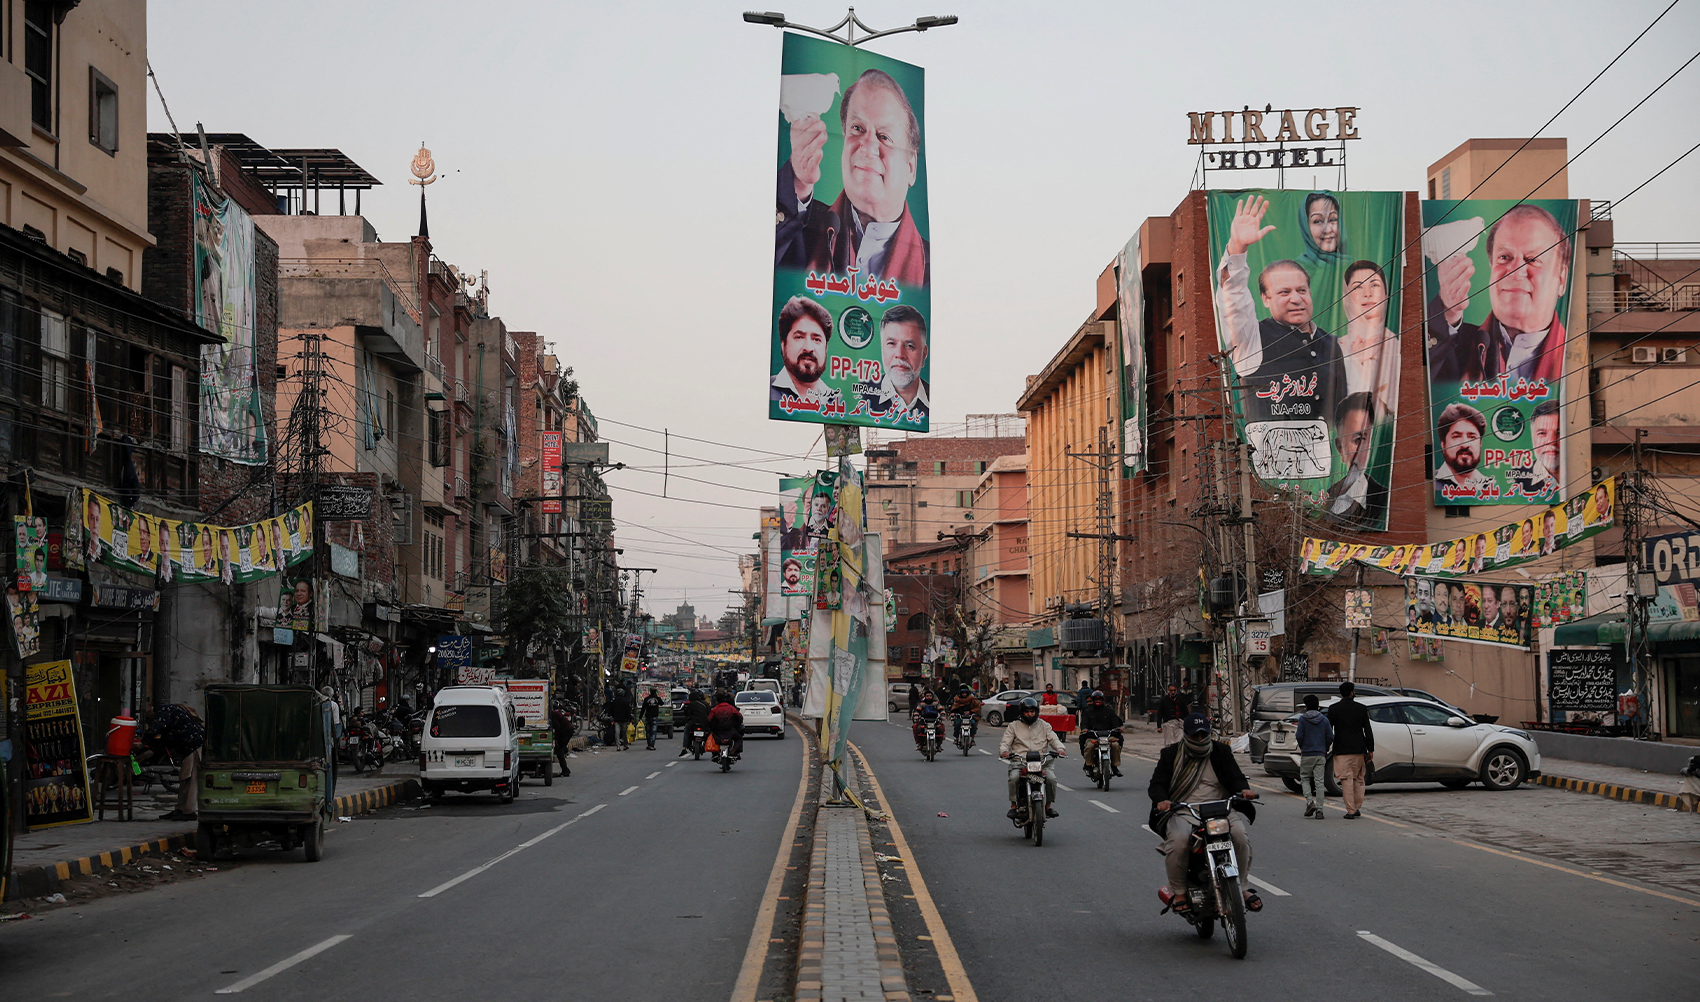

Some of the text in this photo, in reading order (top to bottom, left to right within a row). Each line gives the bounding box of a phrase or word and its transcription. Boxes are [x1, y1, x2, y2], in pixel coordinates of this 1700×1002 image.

[1187, 107, 1358, 144] MIRAGE
[1219, 147, 1333, 170] HOTEL
[806, 267, 901, 303] خوش آمدید
[831, 356, 882, 382] PP-173
[852, 383, 869, 394] MPA
[1256, 373, 1318, 403] محمد نواز شریف
[1461, 375, 1549, 401] خوش آمدید
[779, 394, 846, 418] بابر محمود
[1270, 403, 1311, 416] NA-130
[1485, 449, 1533, 469] PP-173
[1442, 484, 1500, 500] بابر محمود
[1016, 537, 1027, 545] RA
[1251, 631, 1269, 639] 3272
[1593, 665, 1615, 683] چوہدری
[26, 683, 72, 705] AZI
[1594, 685, 1615, 700] چوہدری
[26, 698, 74, 711] ERPRISES
